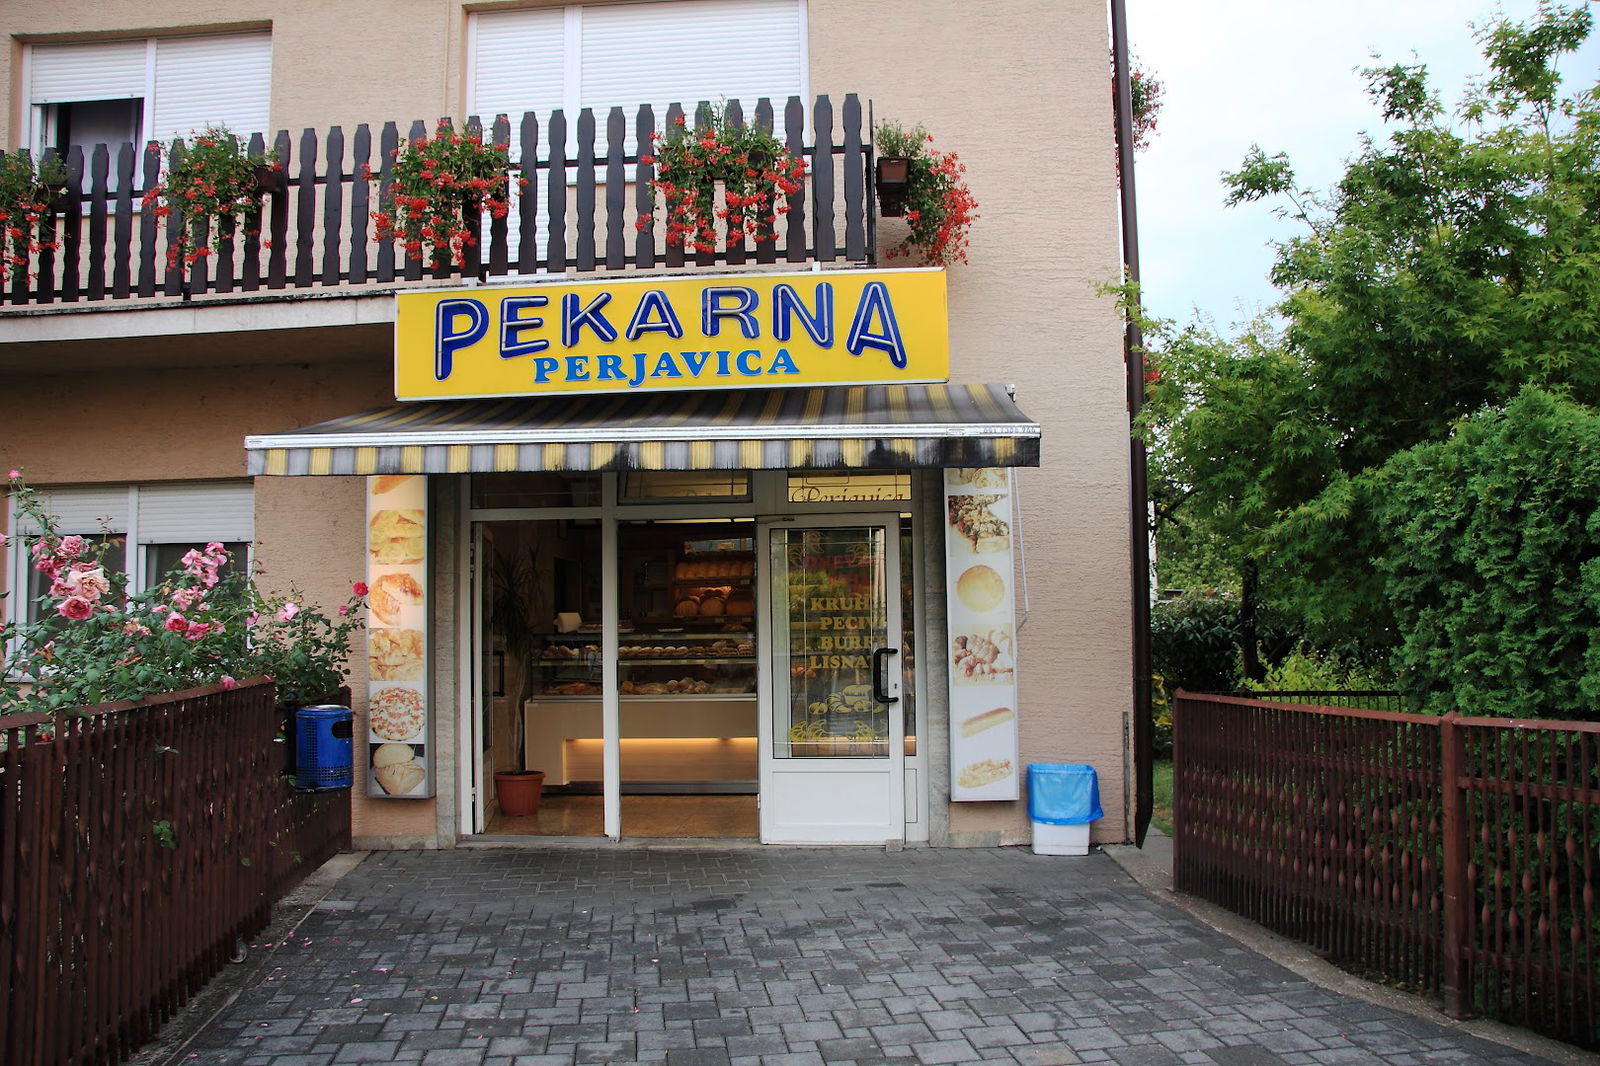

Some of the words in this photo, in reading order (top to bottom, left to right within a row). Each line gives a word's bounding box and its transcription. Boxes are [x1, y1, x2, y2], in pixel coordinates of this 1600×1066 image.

[436, 281, 908, 381] PEKARNA
[532, 348, 800, 388] PERJAVICA
[810, 597, 870, 611] KRUH
